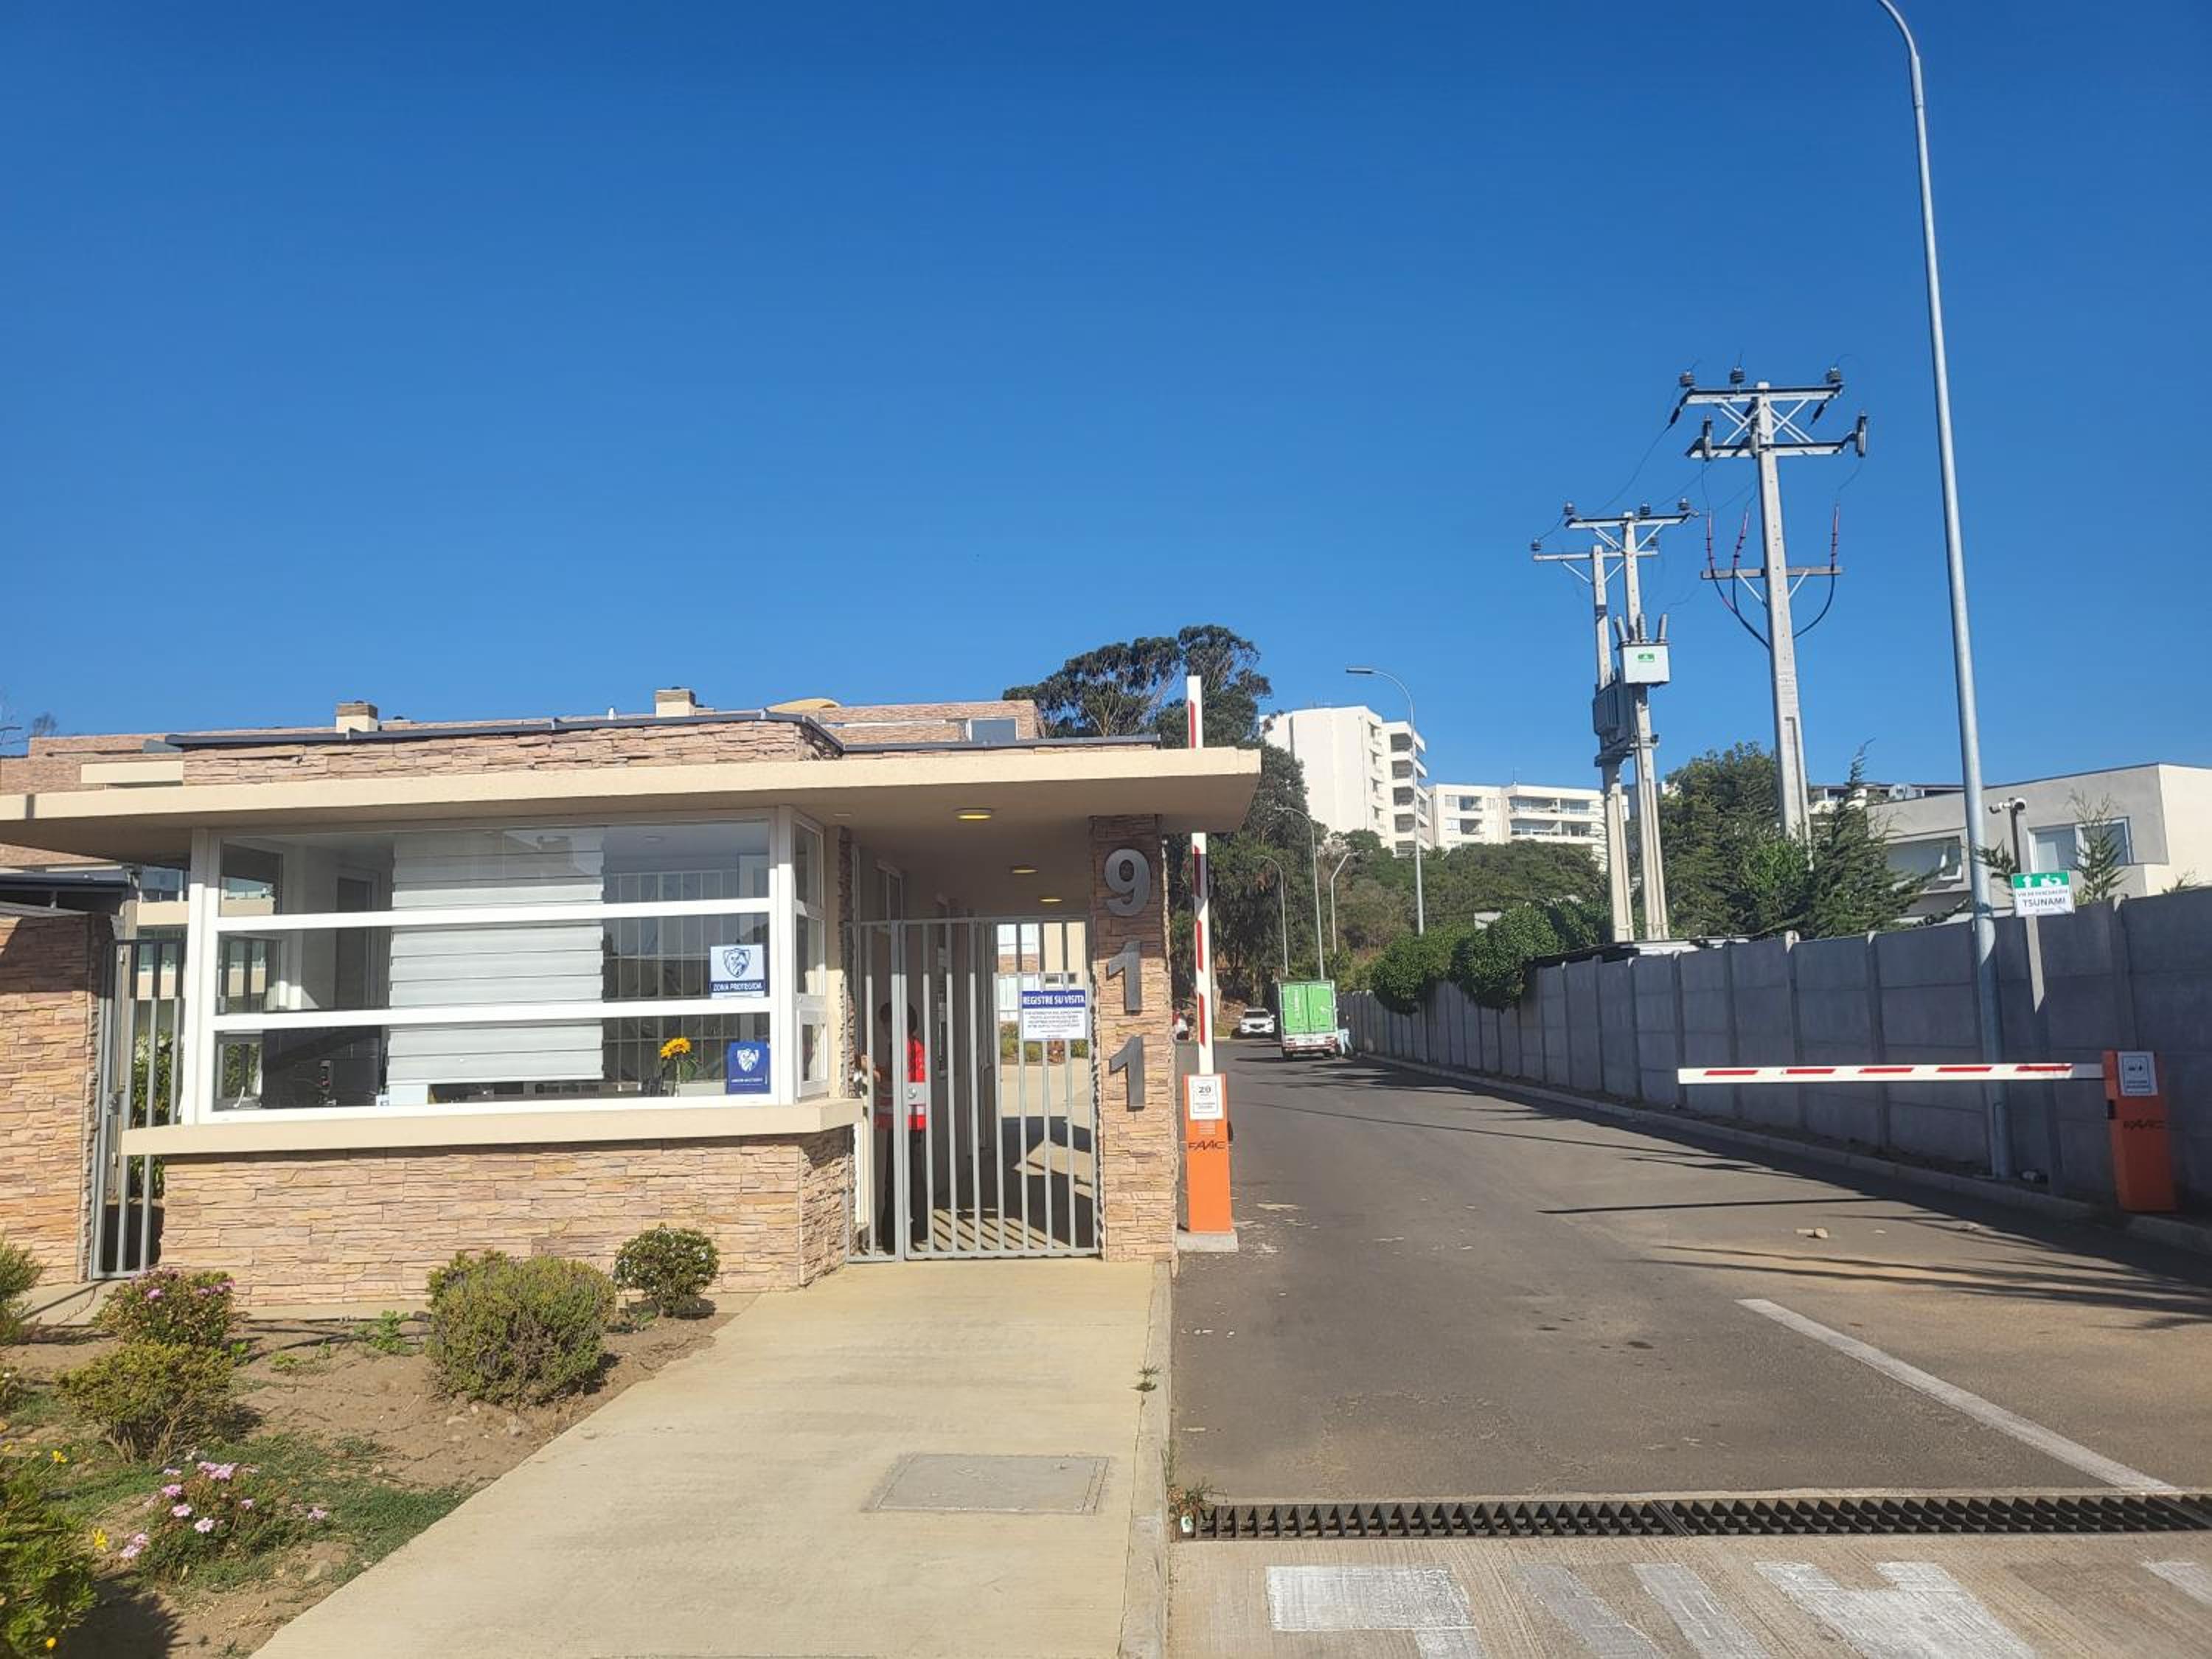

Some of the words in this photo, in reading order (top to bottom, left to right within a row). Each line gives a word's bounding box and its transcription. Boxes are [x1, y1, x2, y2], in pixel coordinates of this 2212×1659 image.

[2023, 897, 2065, 907] TSUNAMI
[713, 983, 728, 992] ZONA
[729, 982, 763, 991] PROTEGIDA
[1023, 996, 1053, 1005] REGISTRE
[1054, 995, 1063, 1004] SU
[1064, 995, 1085, 1004] VISITA
[1188, 1140, 1225, 1151] FAAC
